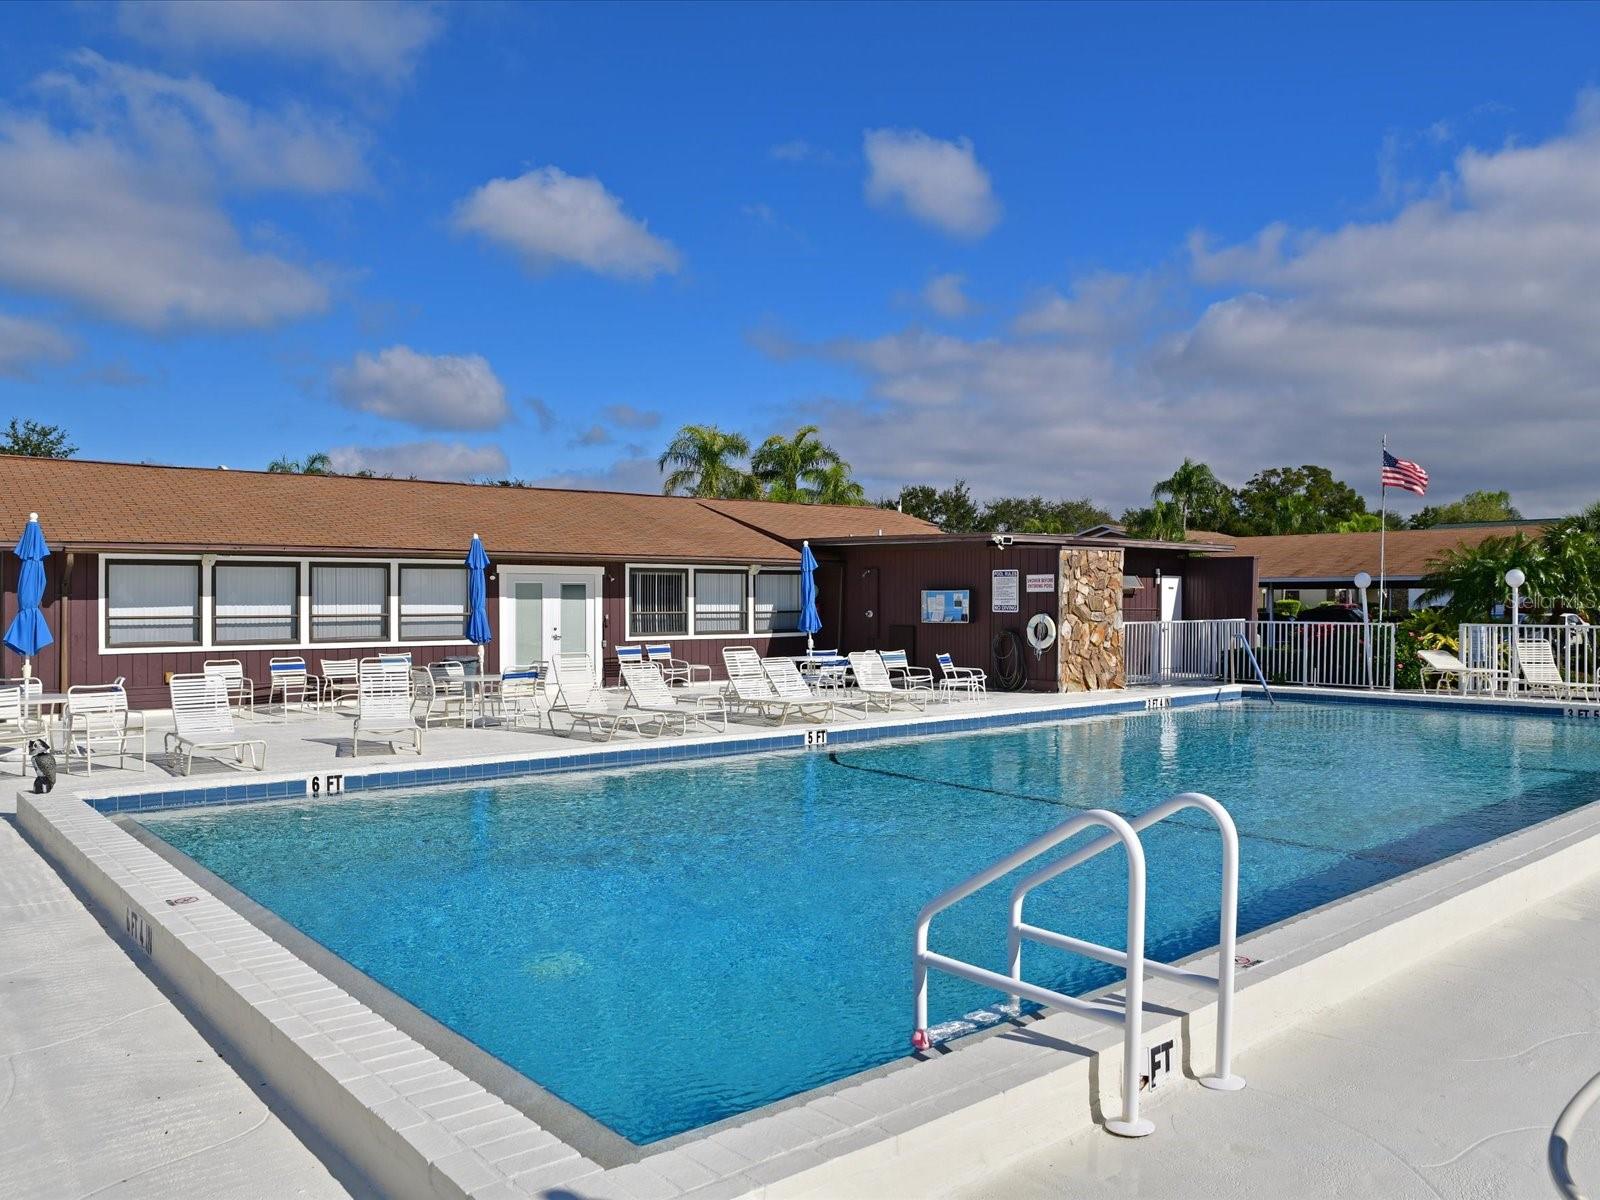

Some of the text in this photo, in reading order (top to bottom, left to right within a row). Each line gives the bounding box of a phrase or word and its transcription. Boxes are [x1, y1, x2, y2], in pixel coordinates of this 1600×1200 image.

[1567, 708, 1574, 718] 3
[1577, 709, 1589, 718] FT
[808, 730, 826, 744] 5 FT
[311, 774, 343, 792] 6 FT
[131, 911, 138, 939] FT
[1150, 1039, 1174, 1089] FT
